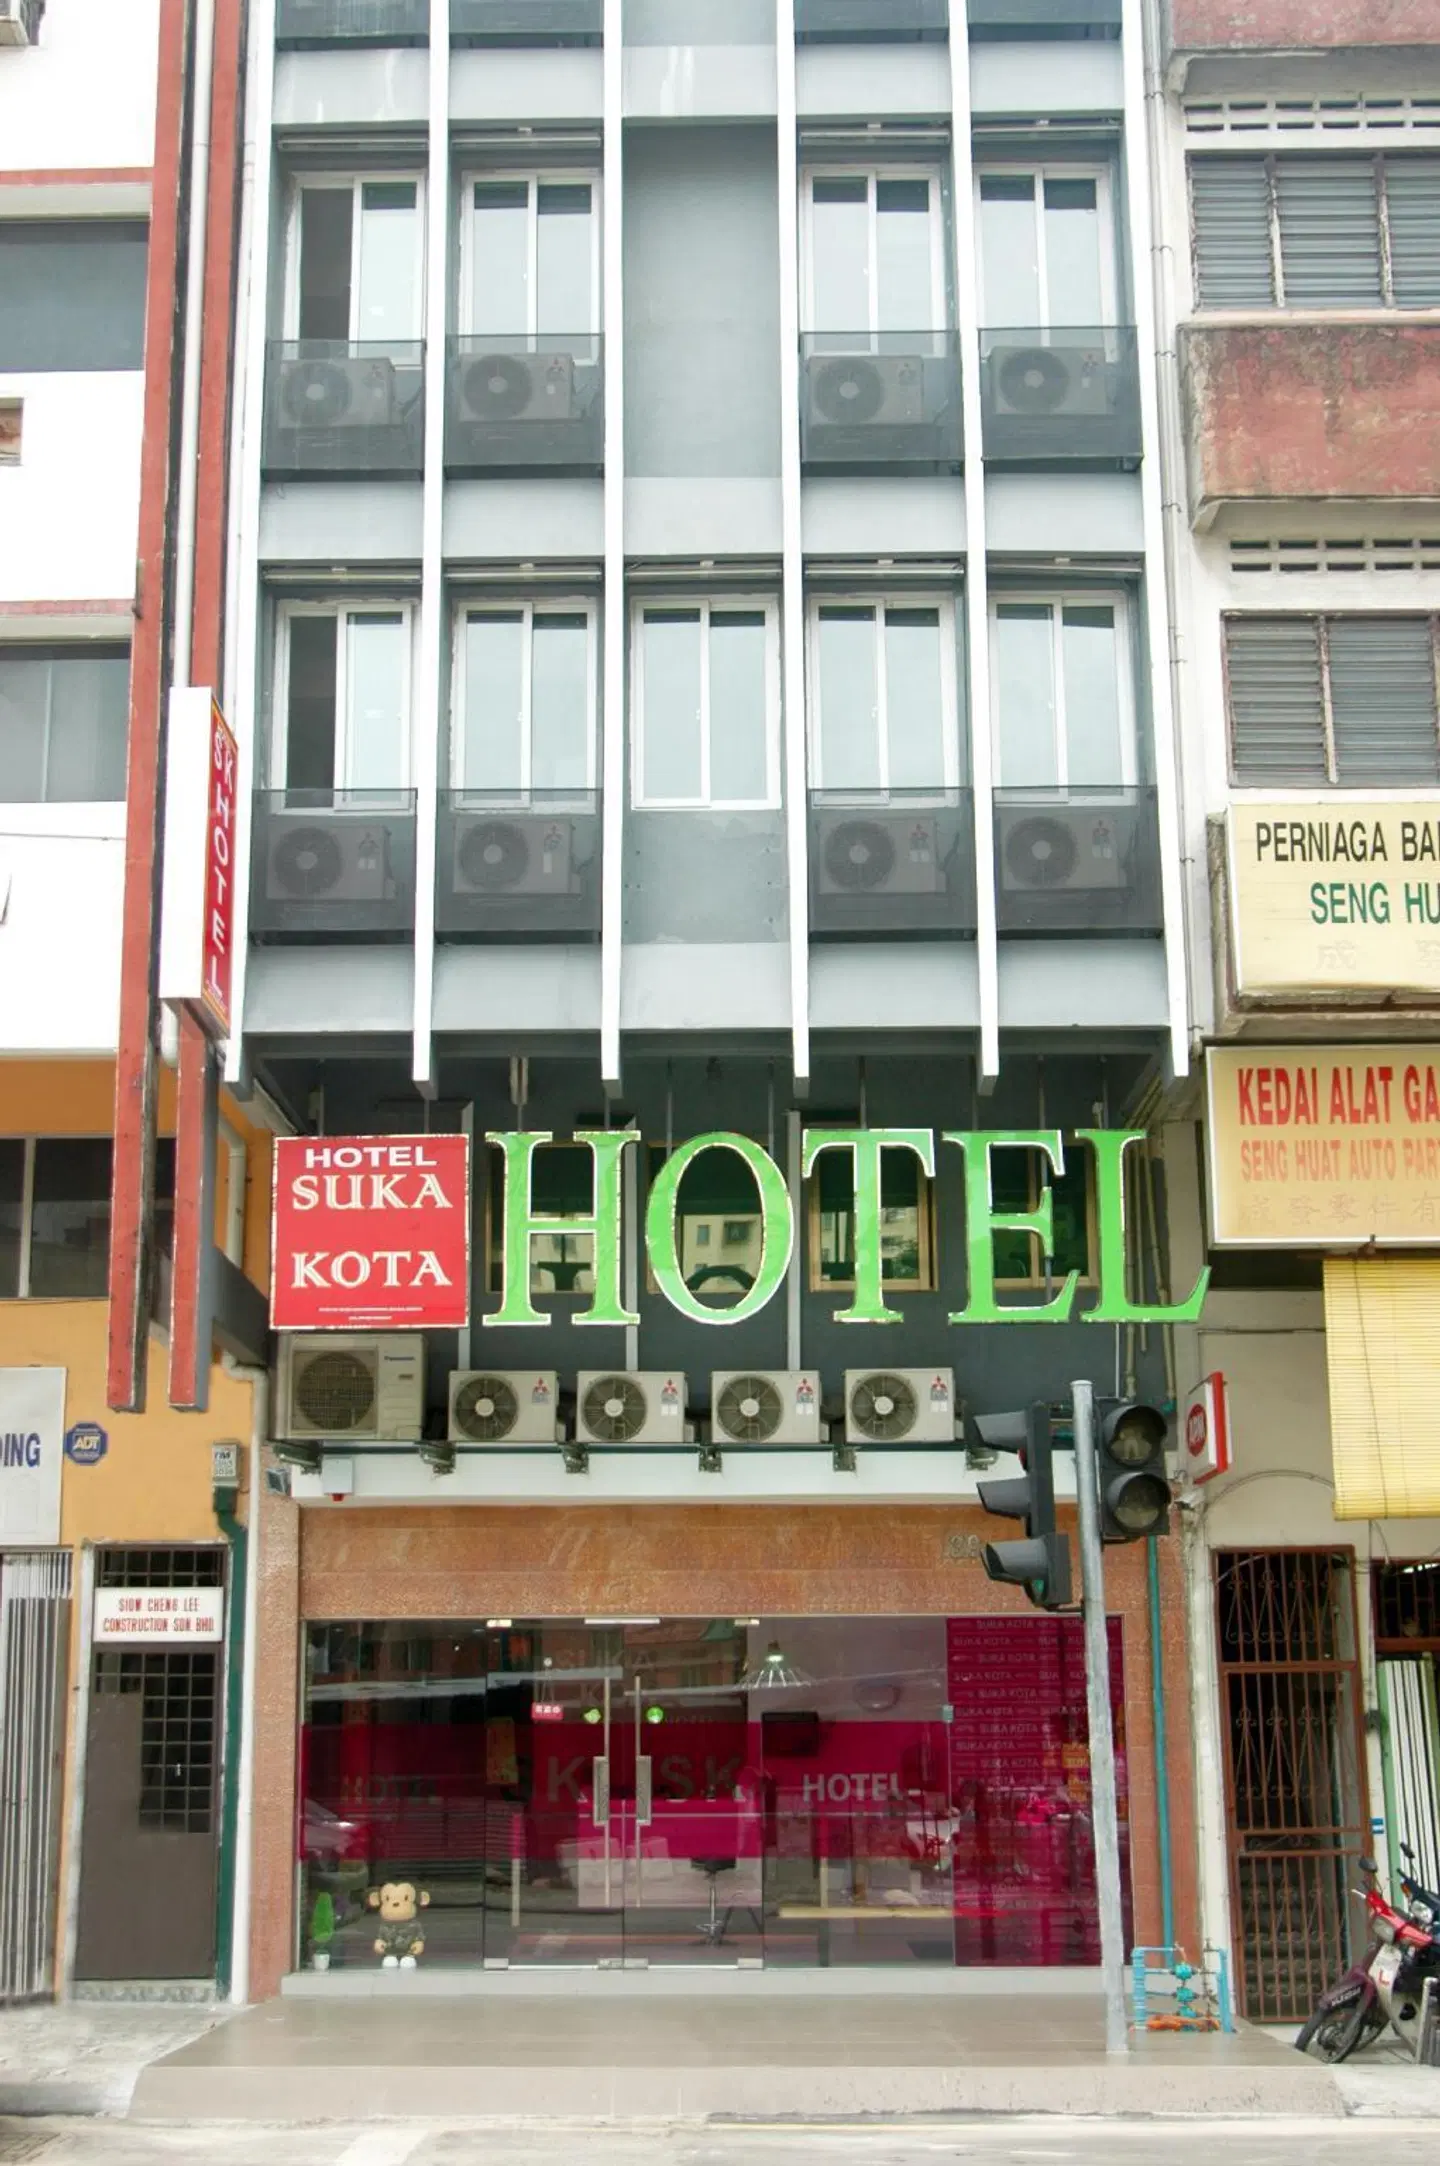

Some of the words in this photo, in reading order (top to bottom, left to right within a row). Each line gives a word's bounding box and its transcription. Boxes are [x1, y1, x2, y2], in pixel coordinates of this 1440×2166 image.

[1256, 821, 1389, 862] PERNIAGA
[1401, 820, 1440, 862] BA
[211, 783, 231, 1001] HOTEL
[1310, 881, 1390, 925] SENG
[1237, 1066, 1319, 1127] KEDAI
[1329, 1065, 1393, 1126] ALAT
[305, 1147, 437, 1169] HOTEL
[1240, 1138, 1289, 1183] SENG
[1295, 1138, 1342, 1182] HUAT
[1349, 1138, 1397, 1181] AUTO
[291, 1174, 453, 1211] SUKA
[482, 1128, 1211, 1326] HOTEL
[291, 1250, 453, 1289] KOTA
[0, 1432, 41, 1467] ING
[73, 1435, 100, 1450] ADT
[183, 1597, 199, 1612] LEE
[102, 1617, 169, 1633] CONSTRUCTION
